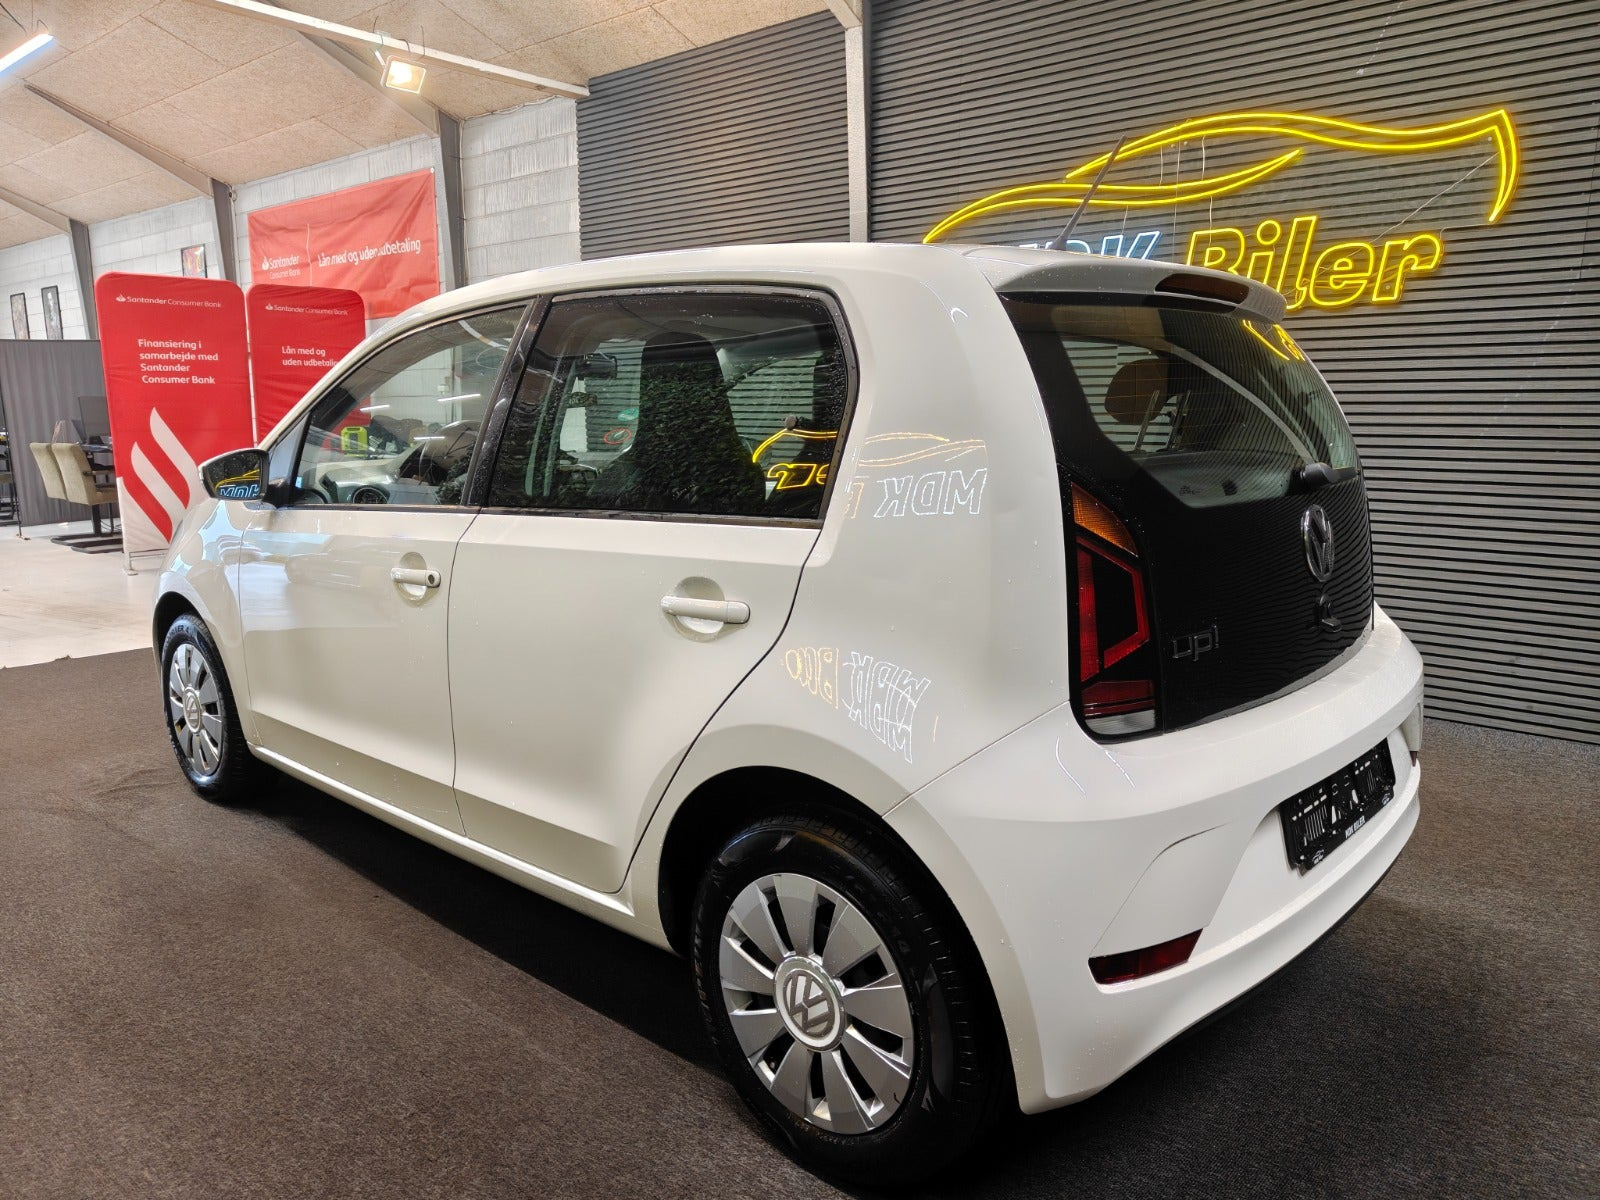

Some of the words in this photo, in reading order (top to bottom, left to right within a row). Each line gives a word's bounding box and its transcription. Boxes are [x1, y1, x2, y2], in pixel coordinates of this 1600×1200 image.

[318, 252, 330, 266] Lån
[331, 250, 346, 264] med
[348, 251, 358, 265] og
[359, 246, 378, 260] uden
[270, 255, 299, 269] Santander
[126, 296, 166, 304] Santander
[168, 298, 203, 307] Consumer
[204, 300, 222, 308] Bank
[274, 304, 304, 312] Santander
[138, 338, 196, 350] Finansiering
[282, 346, 296, 354] Lån
[316, 349, 326, 357] og
[140, 352, 196, 362] samarbejde
[282, 358, 302, 366] uden
[140, 363, 190, 372] Santander
[142, 375, 190, 384] Consumer
[192, 376, 216, 384] Bank
